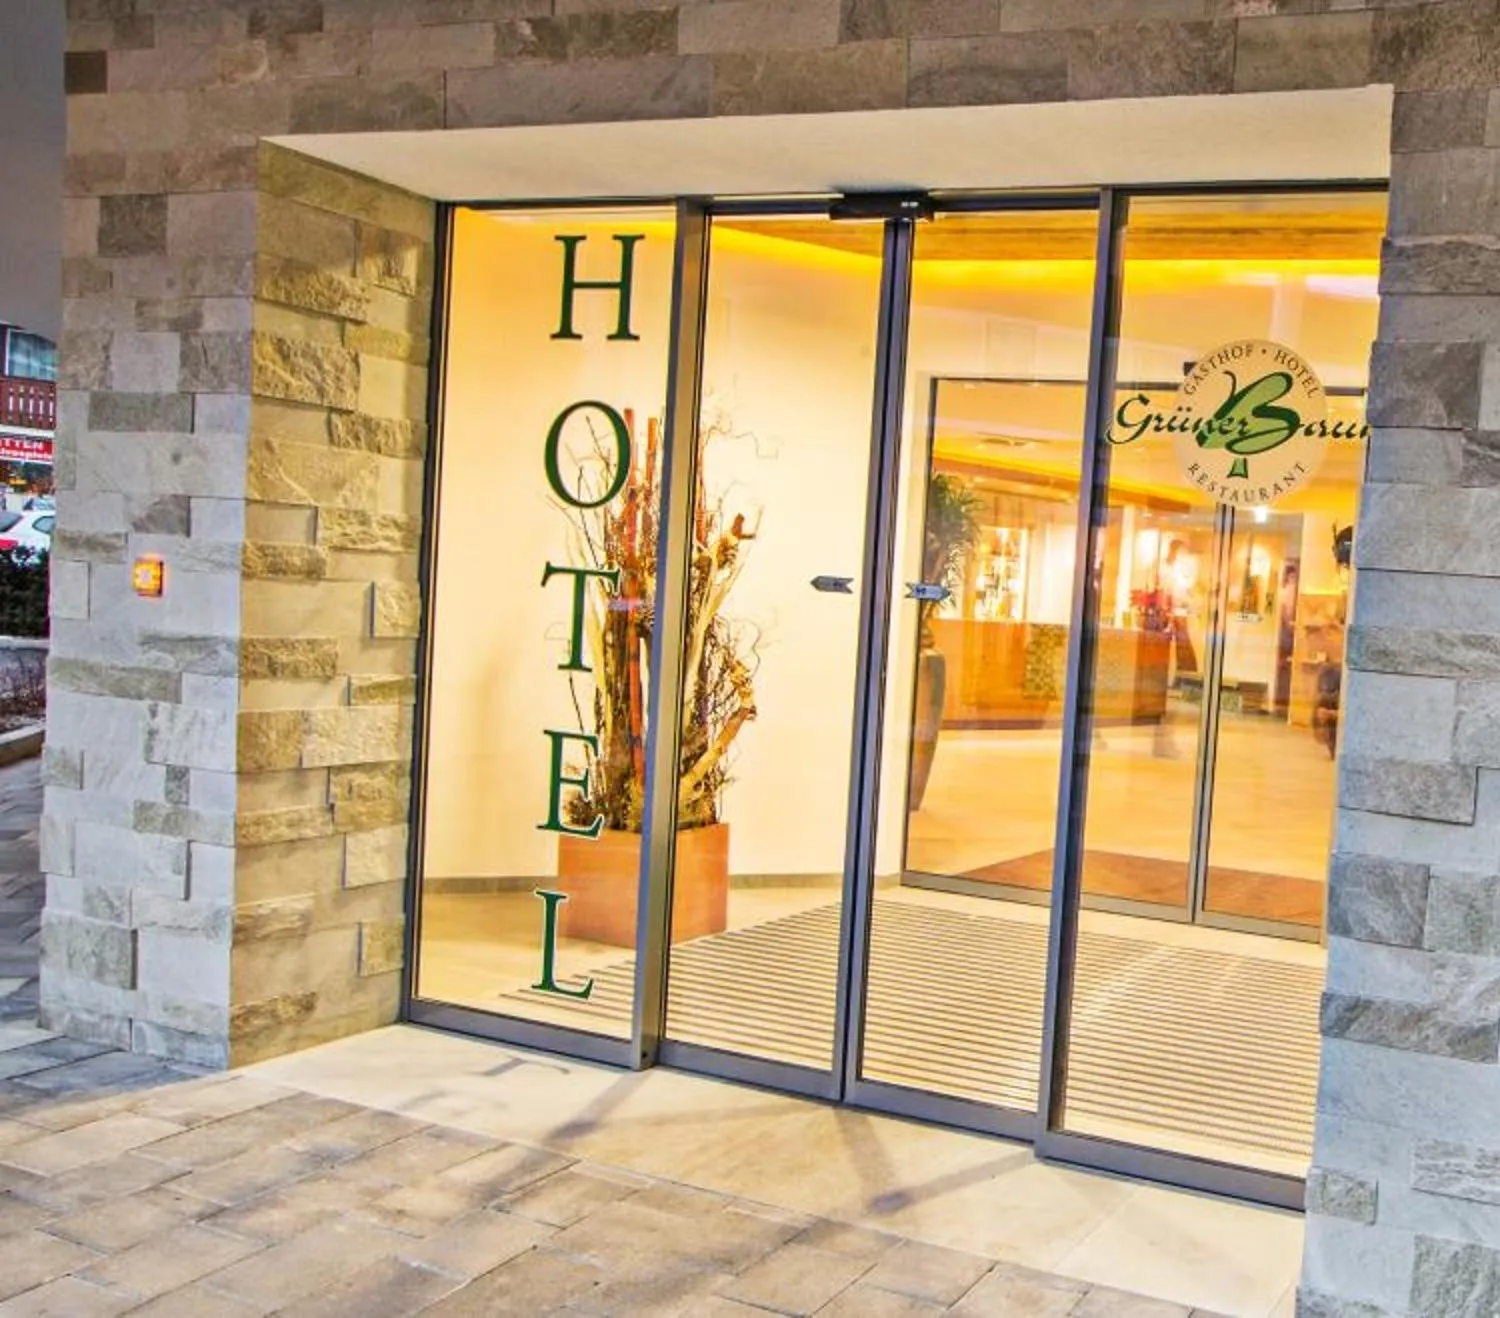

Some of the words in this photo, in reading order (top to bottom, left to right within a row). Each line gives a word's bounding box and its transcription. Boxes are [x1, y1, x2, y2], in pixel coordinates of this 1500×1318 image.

[1184, 346, 1253, 397] GASTHOF
[1274, 348, 1320, 399] HOTEL
[1106, 392, 1250, 445] Grüner
[1187, 462, 1308, 503] RESTAURANT
[531, 233, 646, 1000] HOTEL
